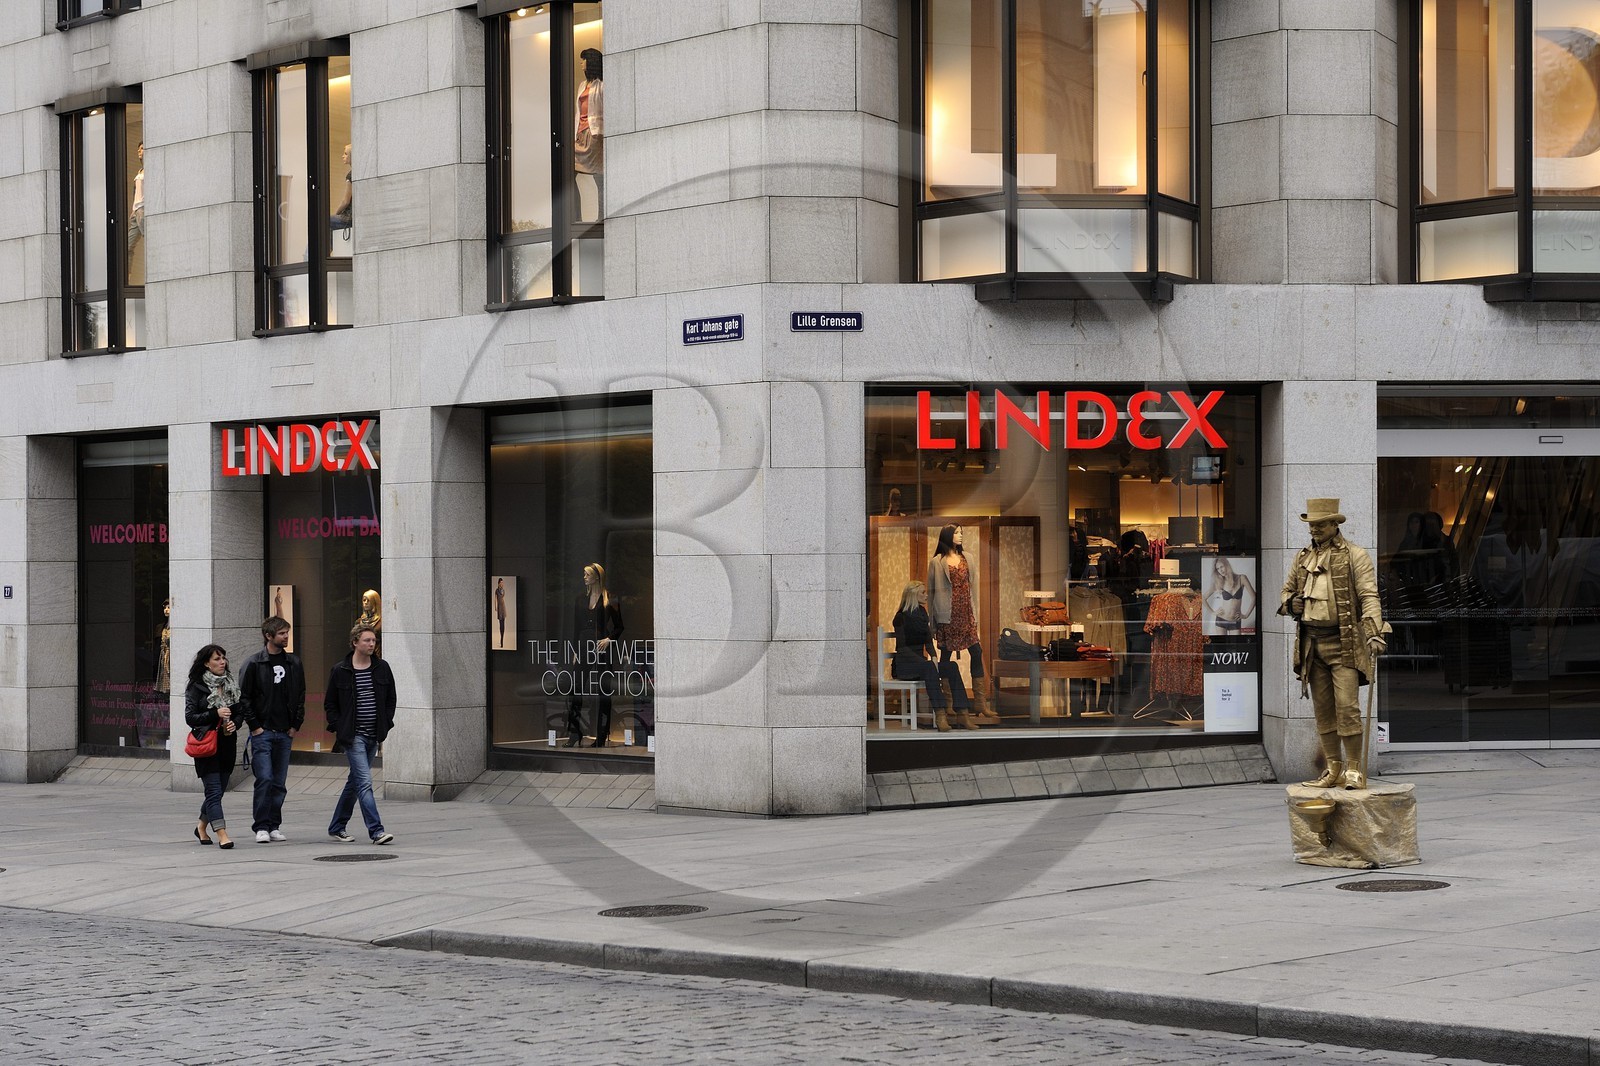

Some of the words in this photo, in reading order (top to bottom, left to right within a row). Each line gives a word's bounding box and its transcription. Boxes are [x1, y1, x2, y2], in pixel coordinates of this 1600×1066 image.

[1539, 234, 1600, 251] LIND
[686, 322, 699, 334] Karl
[701, 321, 723, 333] Johans
[724, 318, 739, 333] gate
[797, 315, 817, 327] Lille
[820, 315, 857, 327] Grensen
[917, 388, 1229, 451] LINDEX
[221, 418, 379, 477] LINDEX
[90, 523, 155, 544] WELCOME
[159, 523, 169, 543] B
[279, 515, 353, 539] WELCOME
[528, 639, 559, 665] THE
[564, 639, 581, 665] IN
[1211, 652, 1249, 665] NOW!
[542, 669, 655, 697] COLLECTION
